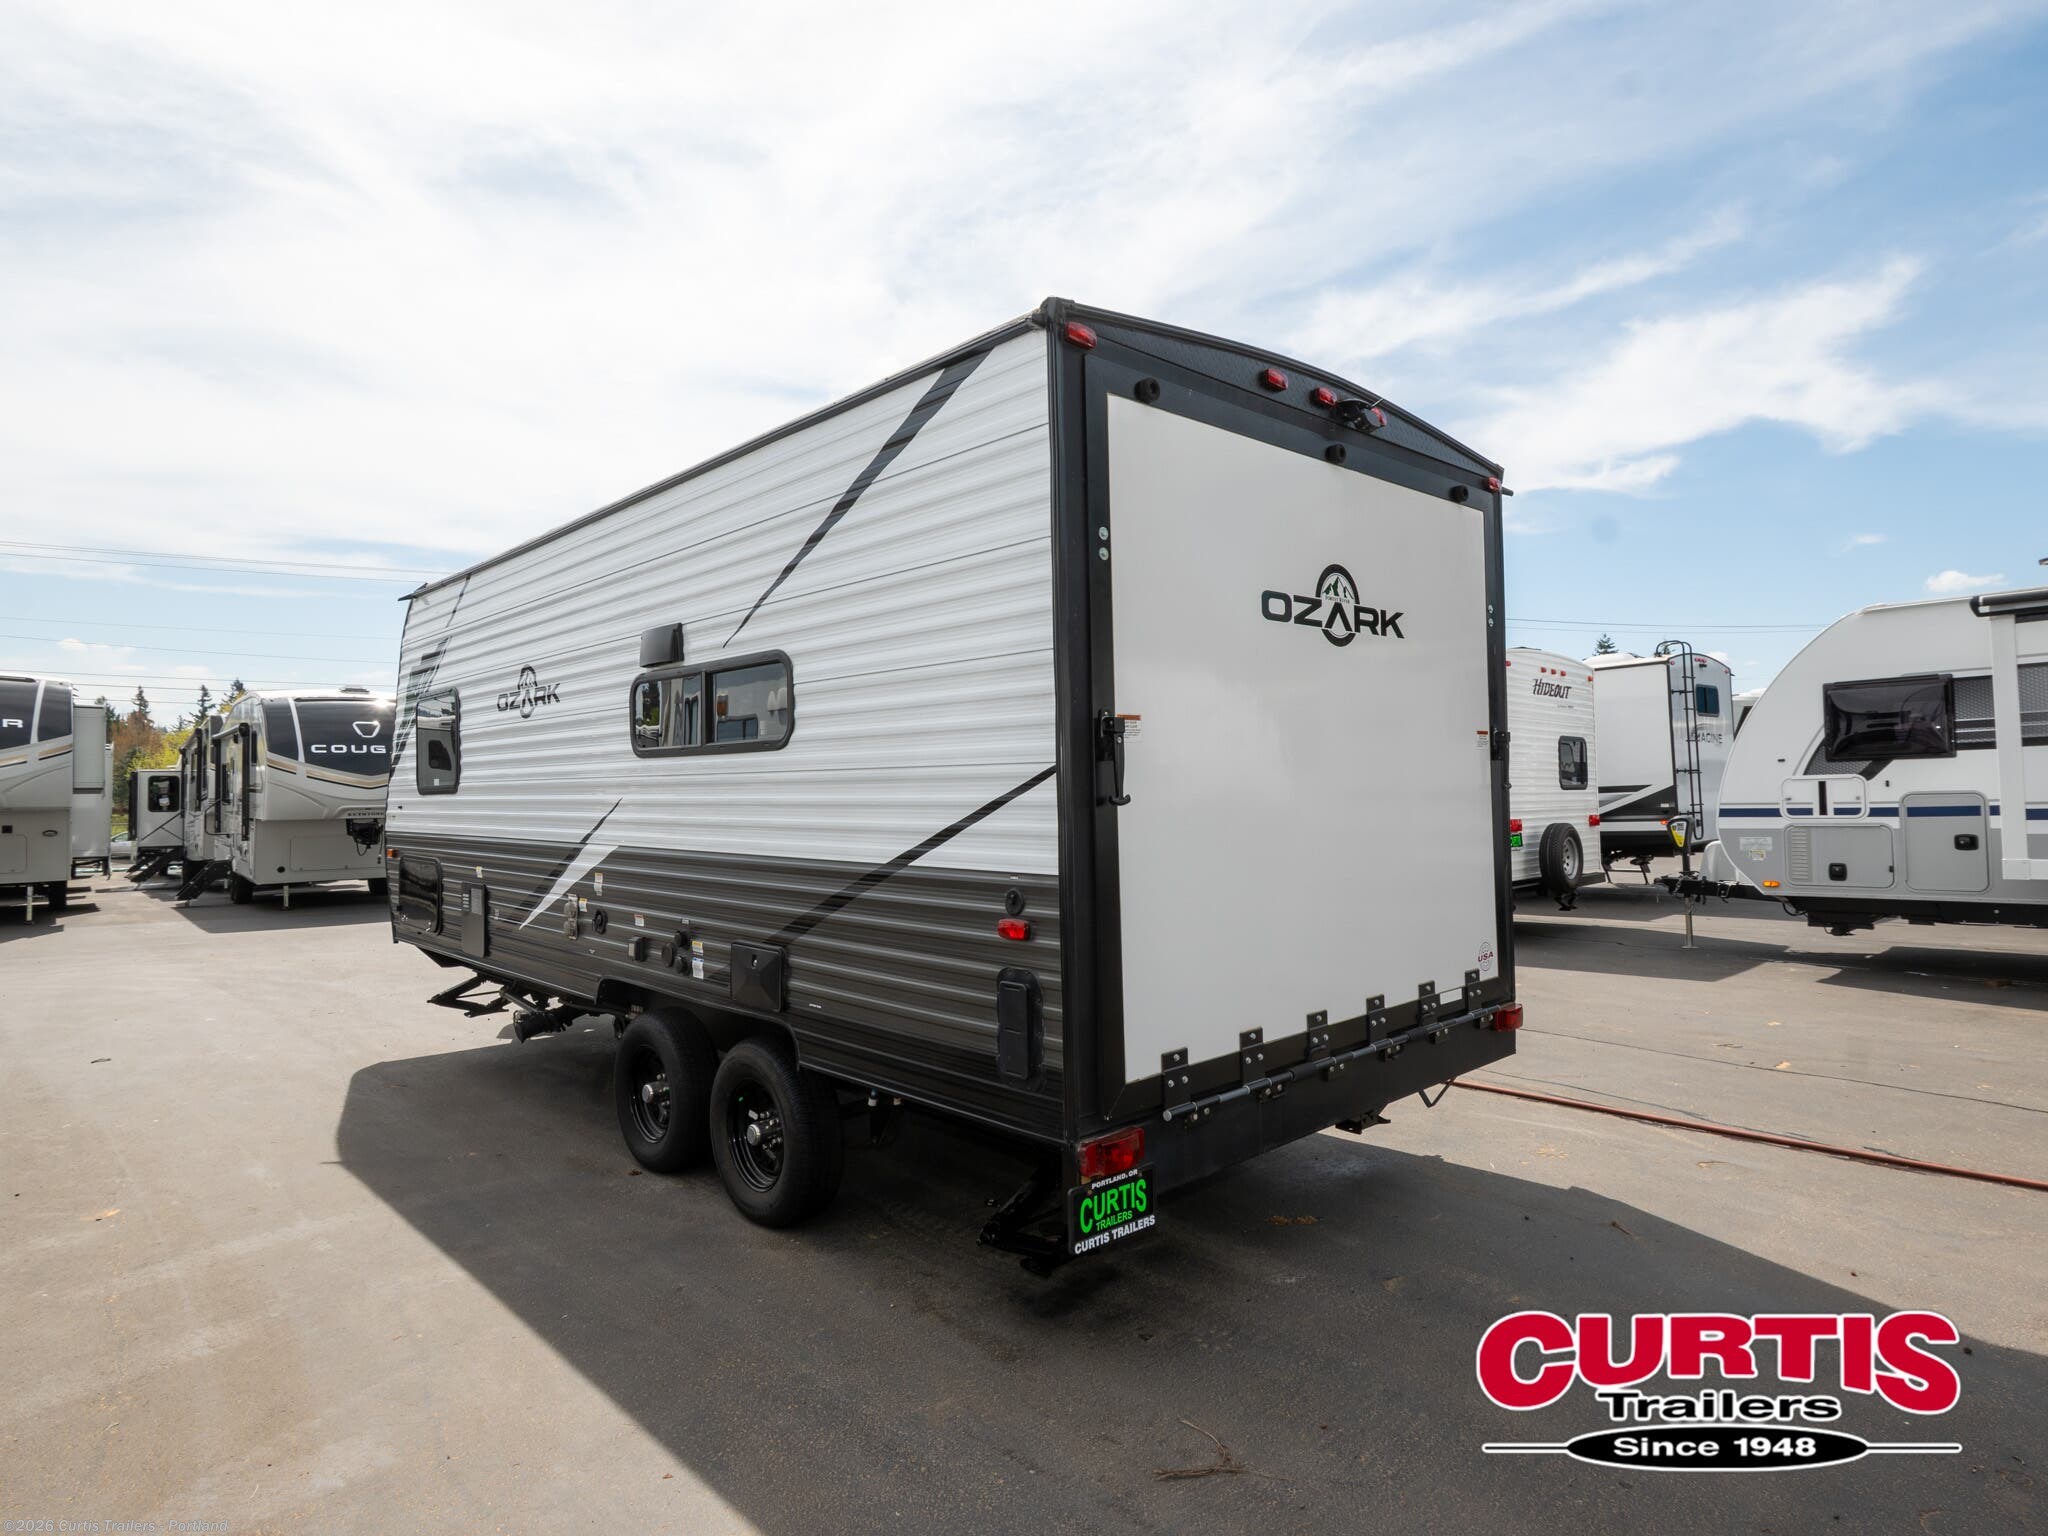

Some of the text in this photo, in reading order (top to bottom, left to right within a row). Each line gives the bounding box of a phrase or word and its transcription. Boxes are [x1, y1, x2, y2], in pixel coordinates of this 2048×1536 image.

[1261, 590, 1405, 639] OZARK
[497, 682, 561, 712] OZARK
[1532, 678, 1572, 699] HIDEOUT
[310, 744, 387, 754] COUG
[1478, 951, 1493, 962] USA
[1128, 1168, 1138, 1178] OR
[1080, 1178, 1147, 1234] CURTIS
[1096, 1210, 1133, 1232] TRAILERS
[1074, 1214, 1155, 1255] CURTIS TRAILERS
